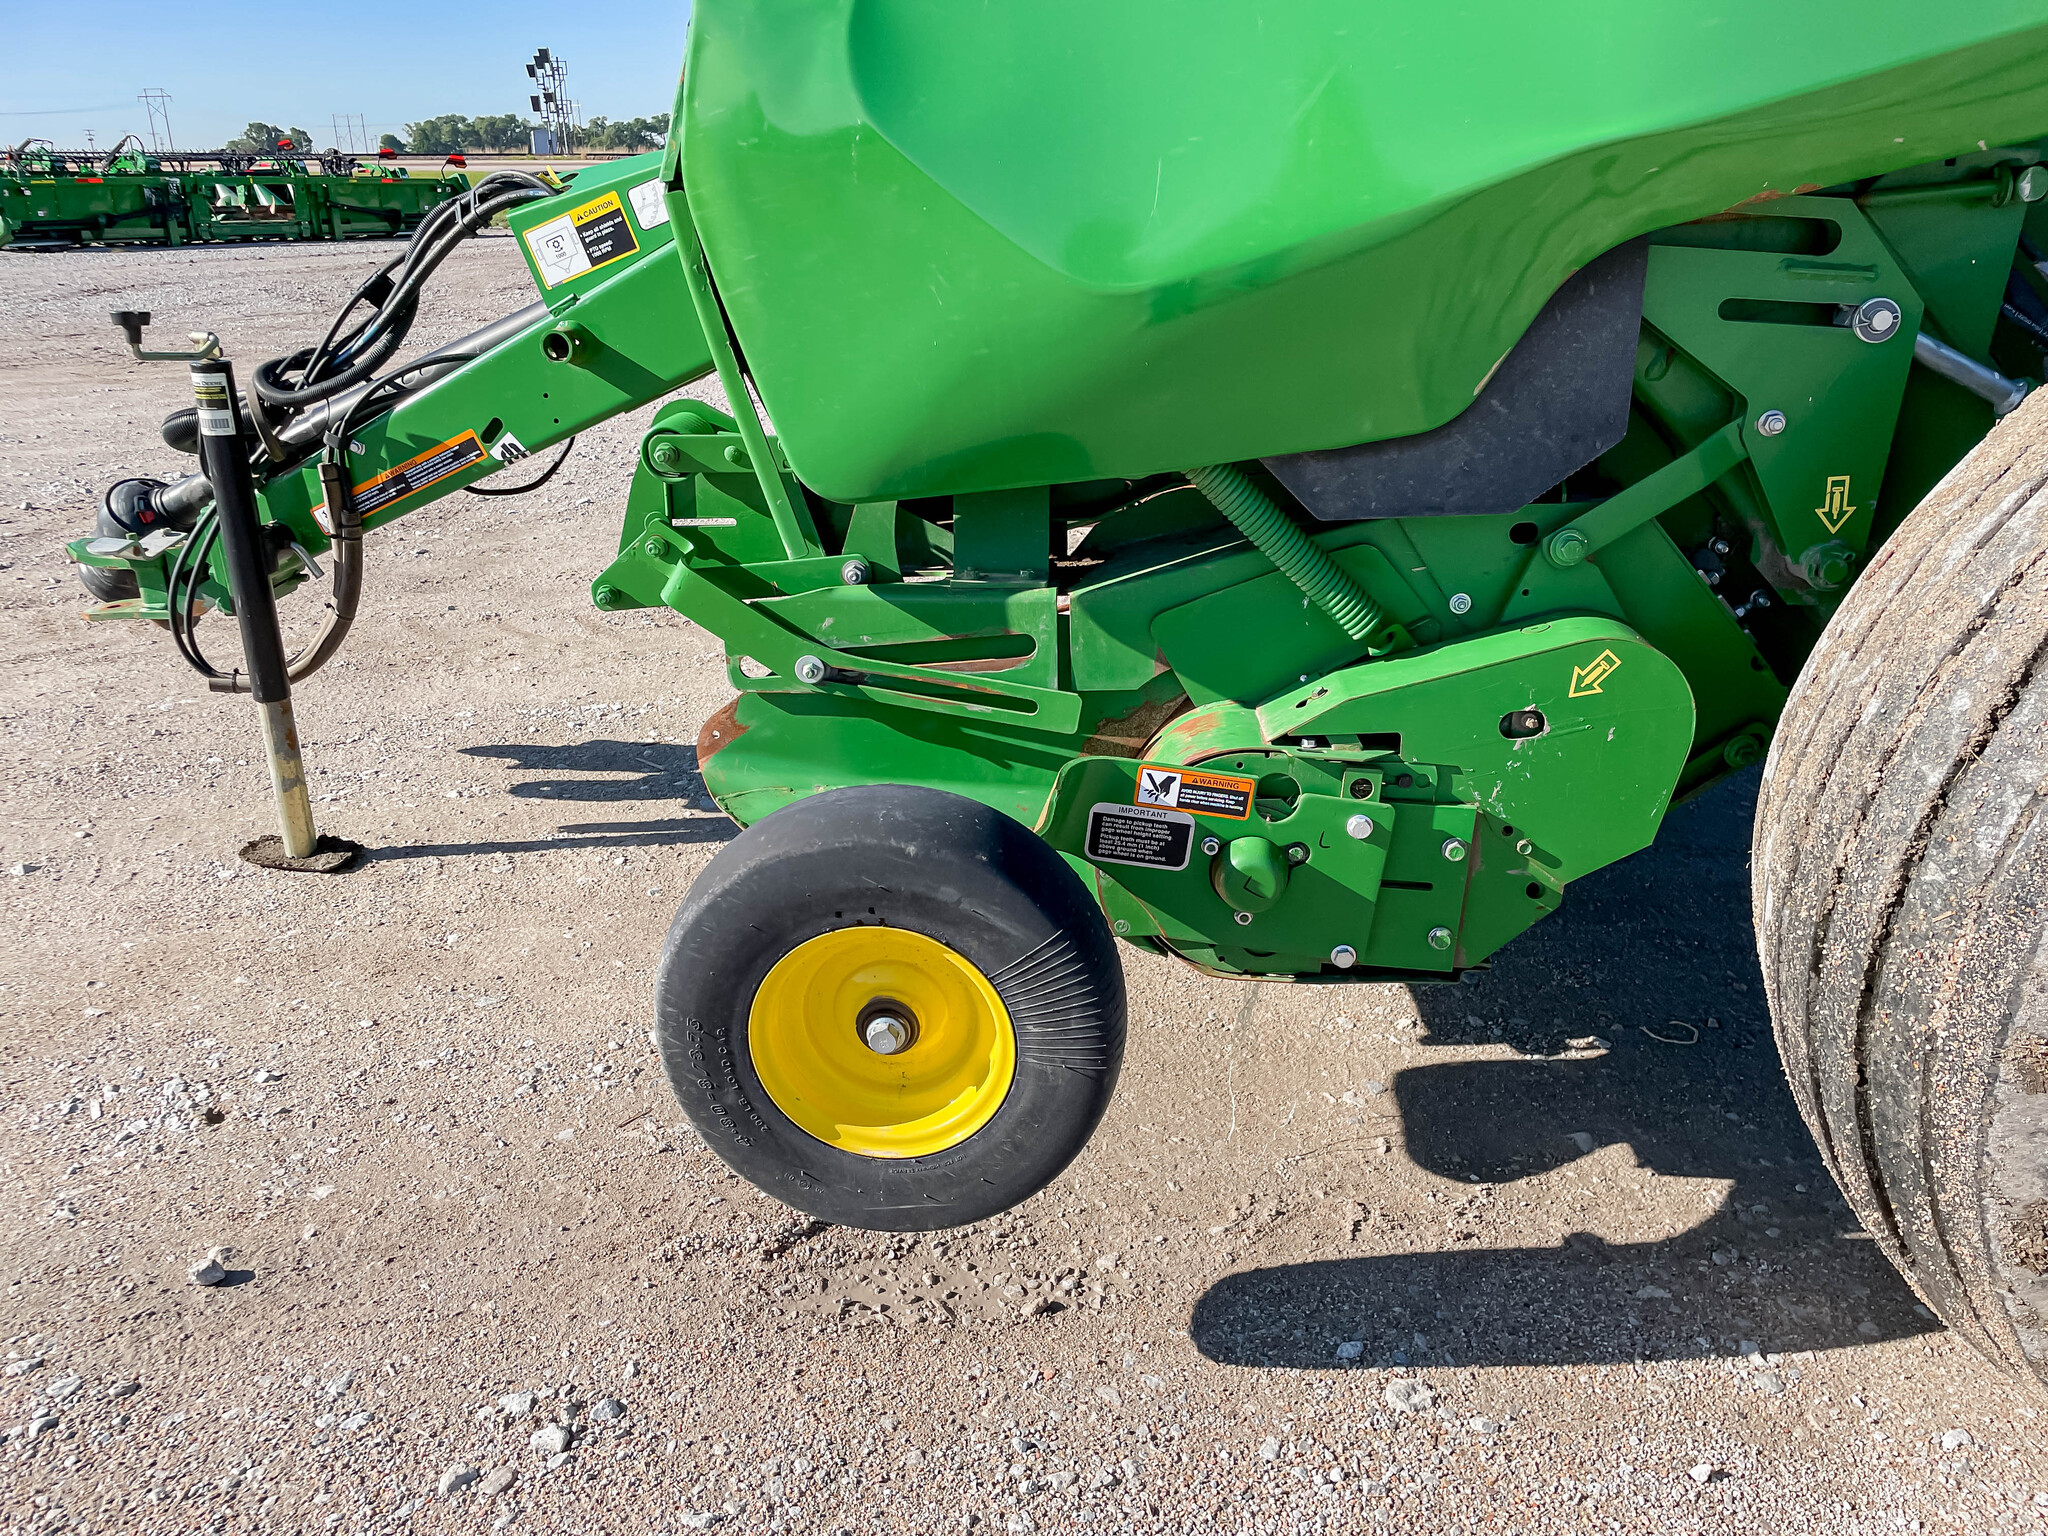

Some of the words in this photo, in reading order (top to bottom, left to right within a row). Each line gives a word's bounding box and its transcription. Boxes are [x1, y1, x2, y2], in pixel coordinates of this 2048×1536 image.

[584, 200, 613, 217] CAUTION
[555, 251, 567, 260] 1000
[390, 460, 417, 477] WARNING
[1200, 778, 1239, 789] WARNING
[1119, 806, 1168, 819] IMPORTANT
[1102, 816, 1126, 824] Damage
[1133, 830, 1152, 838] height
[1145, 827, 1170, 835] improper
